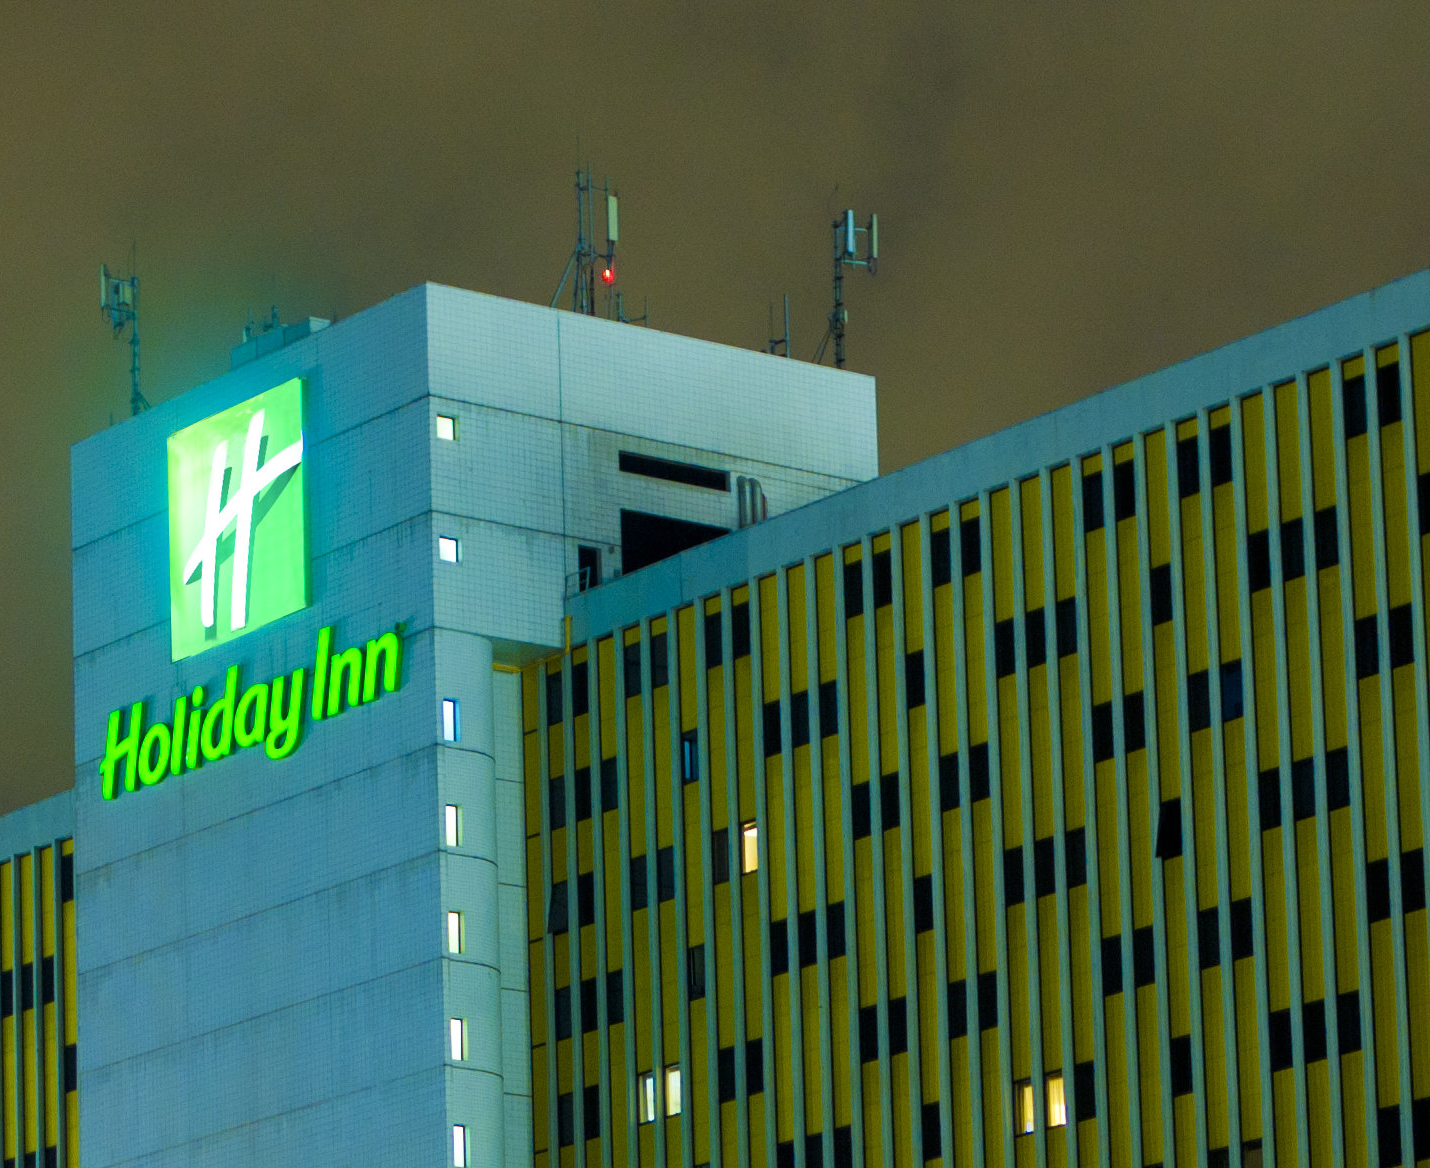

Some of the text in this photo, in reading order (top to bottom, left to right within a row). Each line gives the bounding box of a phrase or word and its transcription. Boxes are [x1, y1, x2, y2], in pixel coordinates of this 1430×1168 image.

[183, 408, 304, 632] H
[100, 625, 403, 800] Holiday Inn
